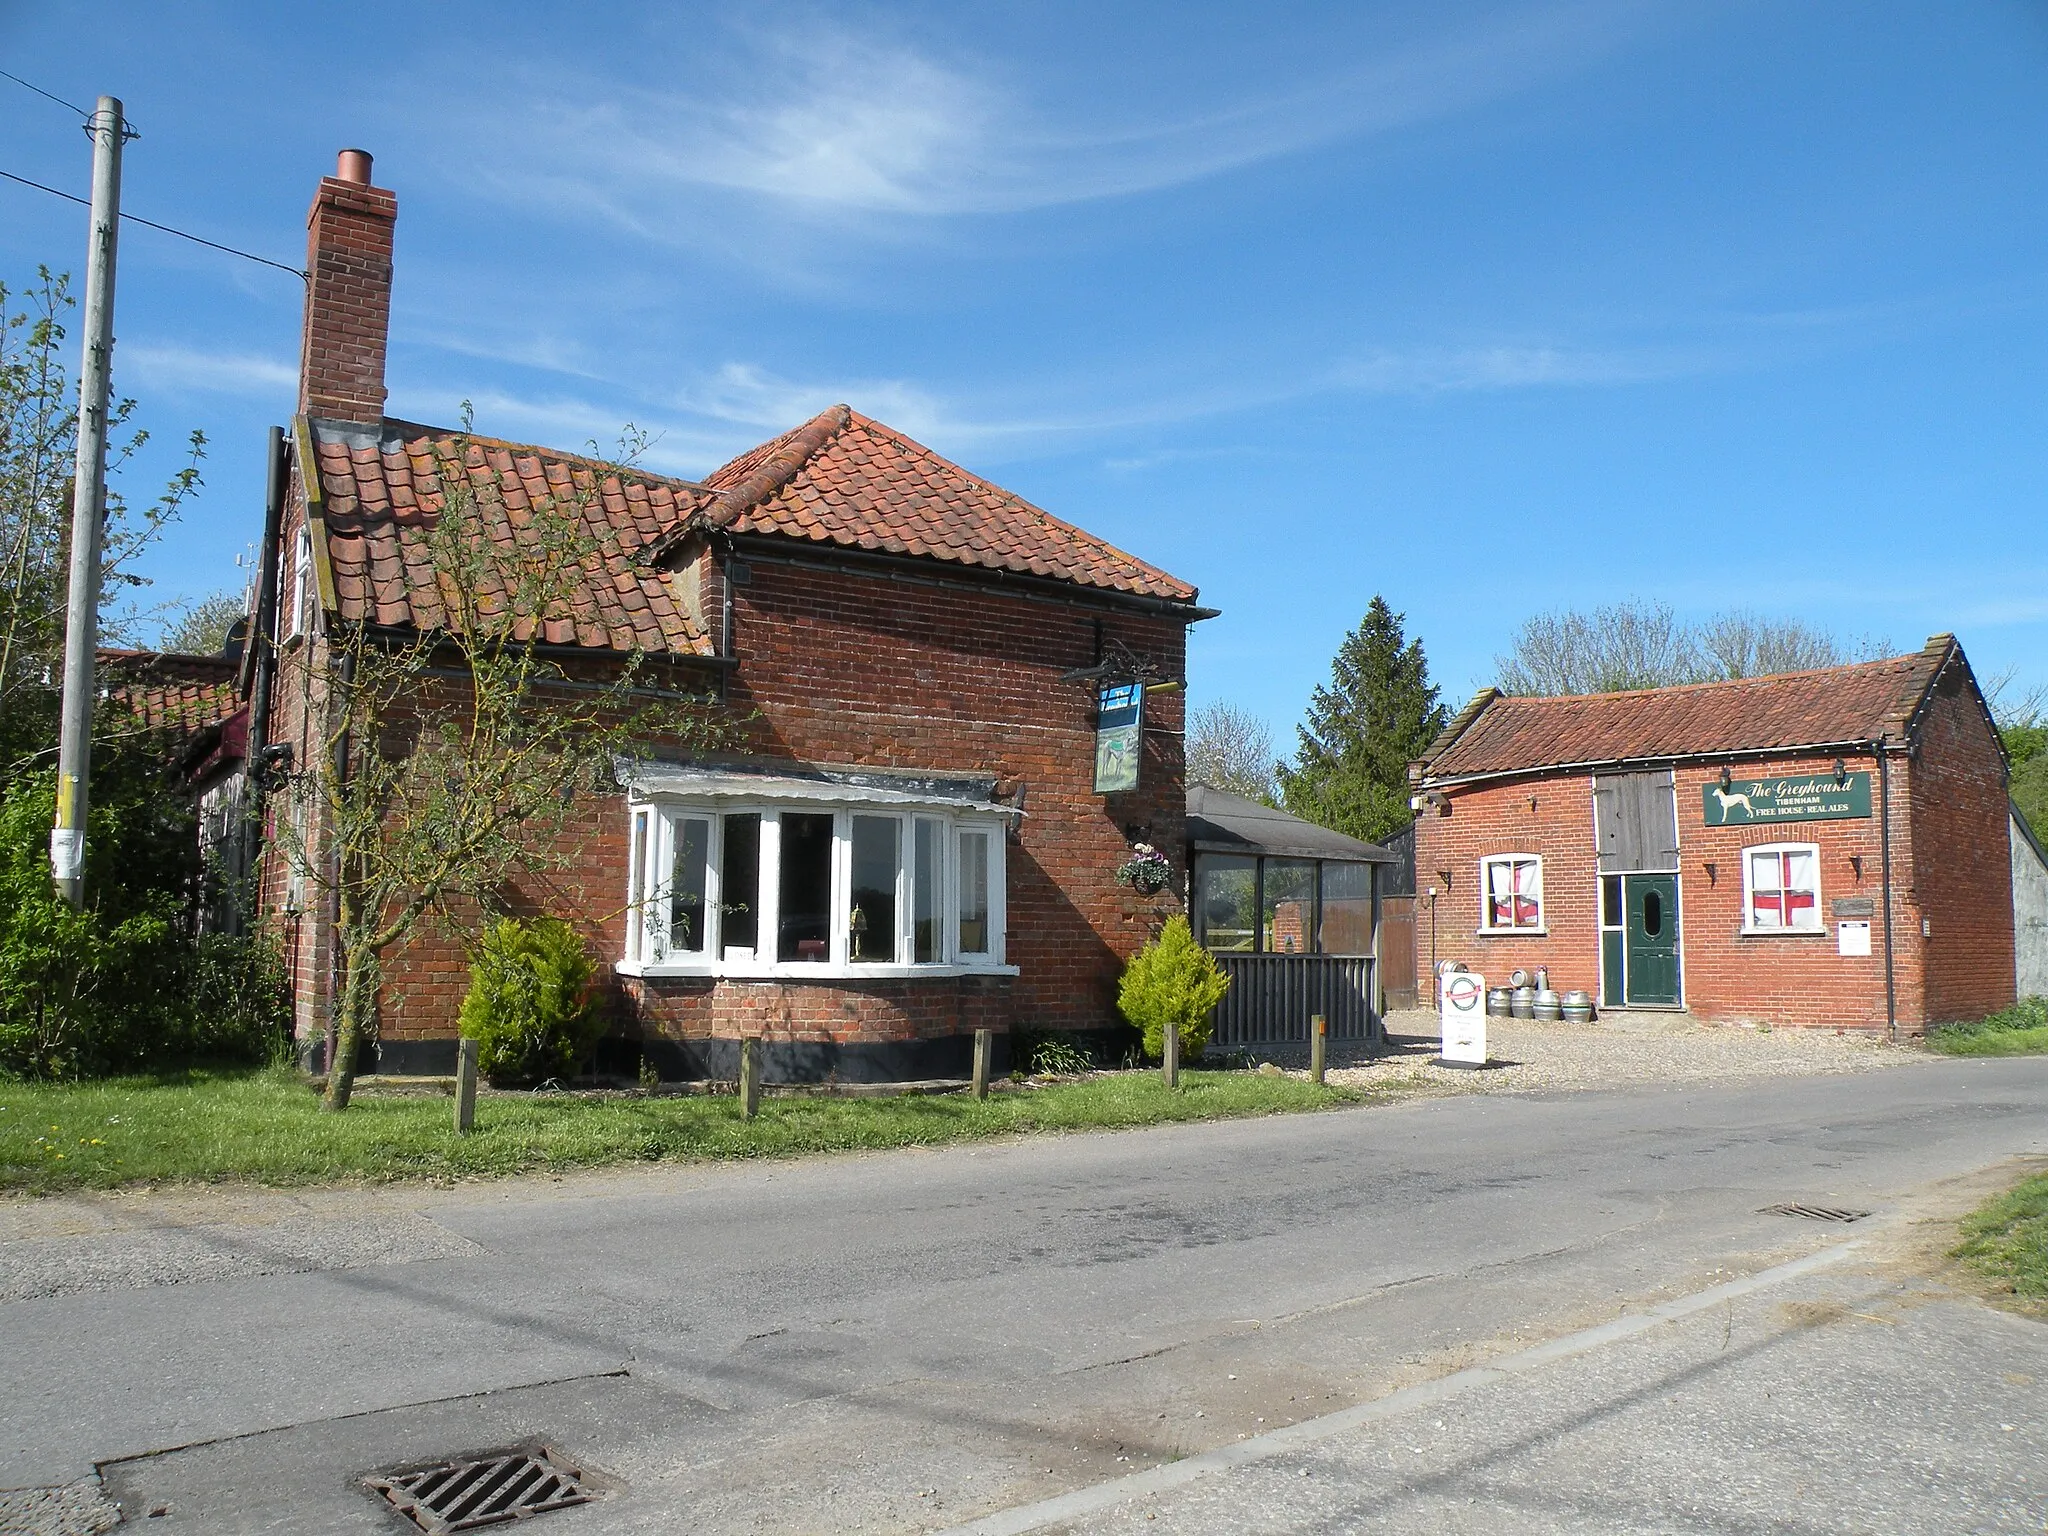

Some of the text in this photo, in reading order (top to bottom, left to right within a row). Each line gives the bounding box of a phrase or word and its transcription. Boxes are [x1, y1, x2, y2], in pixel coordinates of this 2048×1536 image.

[1745, 778, 1854, 799] The Greyhound
[1775, 797, 1820, 806] TIBENHAM
[1755, 804, 1849, 816] FREE HOUSE REAL ALES
